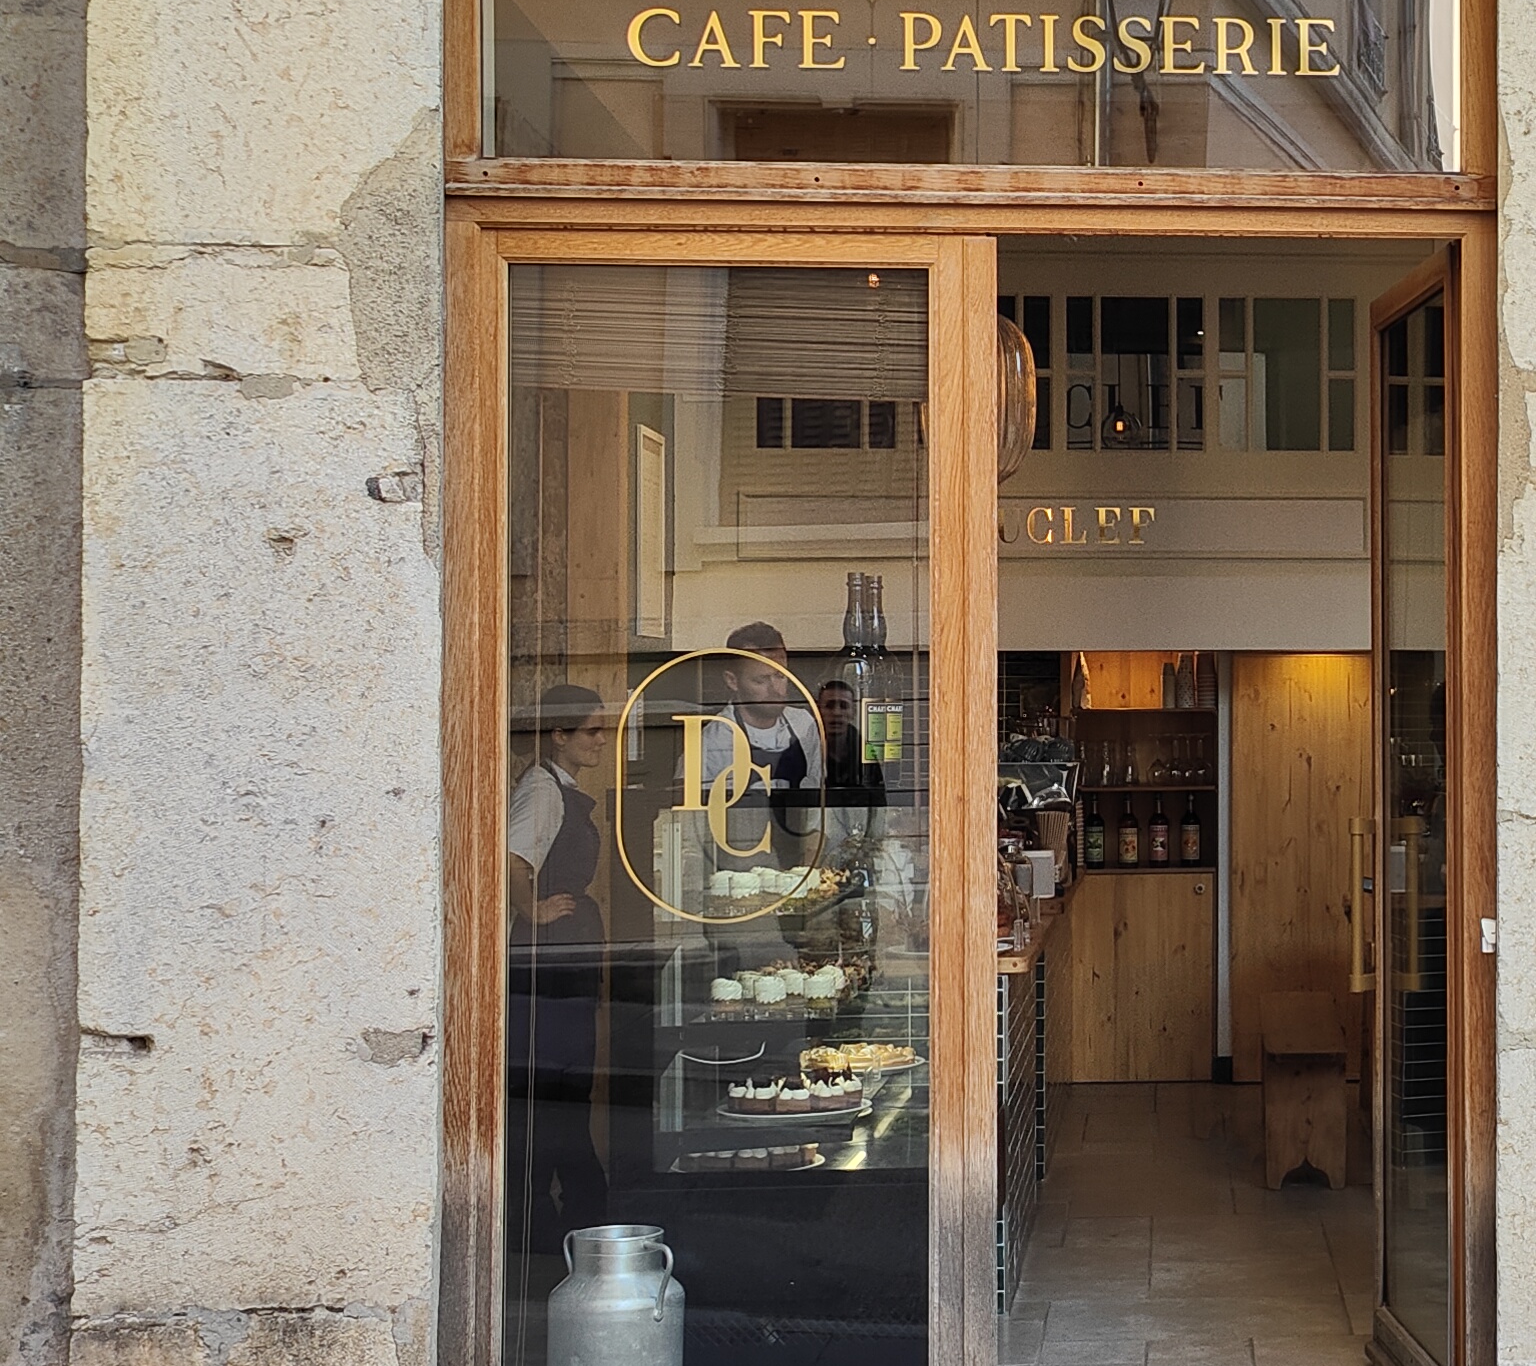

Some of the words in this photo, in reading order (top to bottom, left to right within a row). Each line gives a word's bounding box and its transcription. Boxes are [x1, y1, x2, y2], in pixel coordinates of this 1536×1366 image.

[627, 8, 846, 69] CAFE
[899, 12, 1341, 76] PATISSERIE
[671, 714, 772, 857] DC
